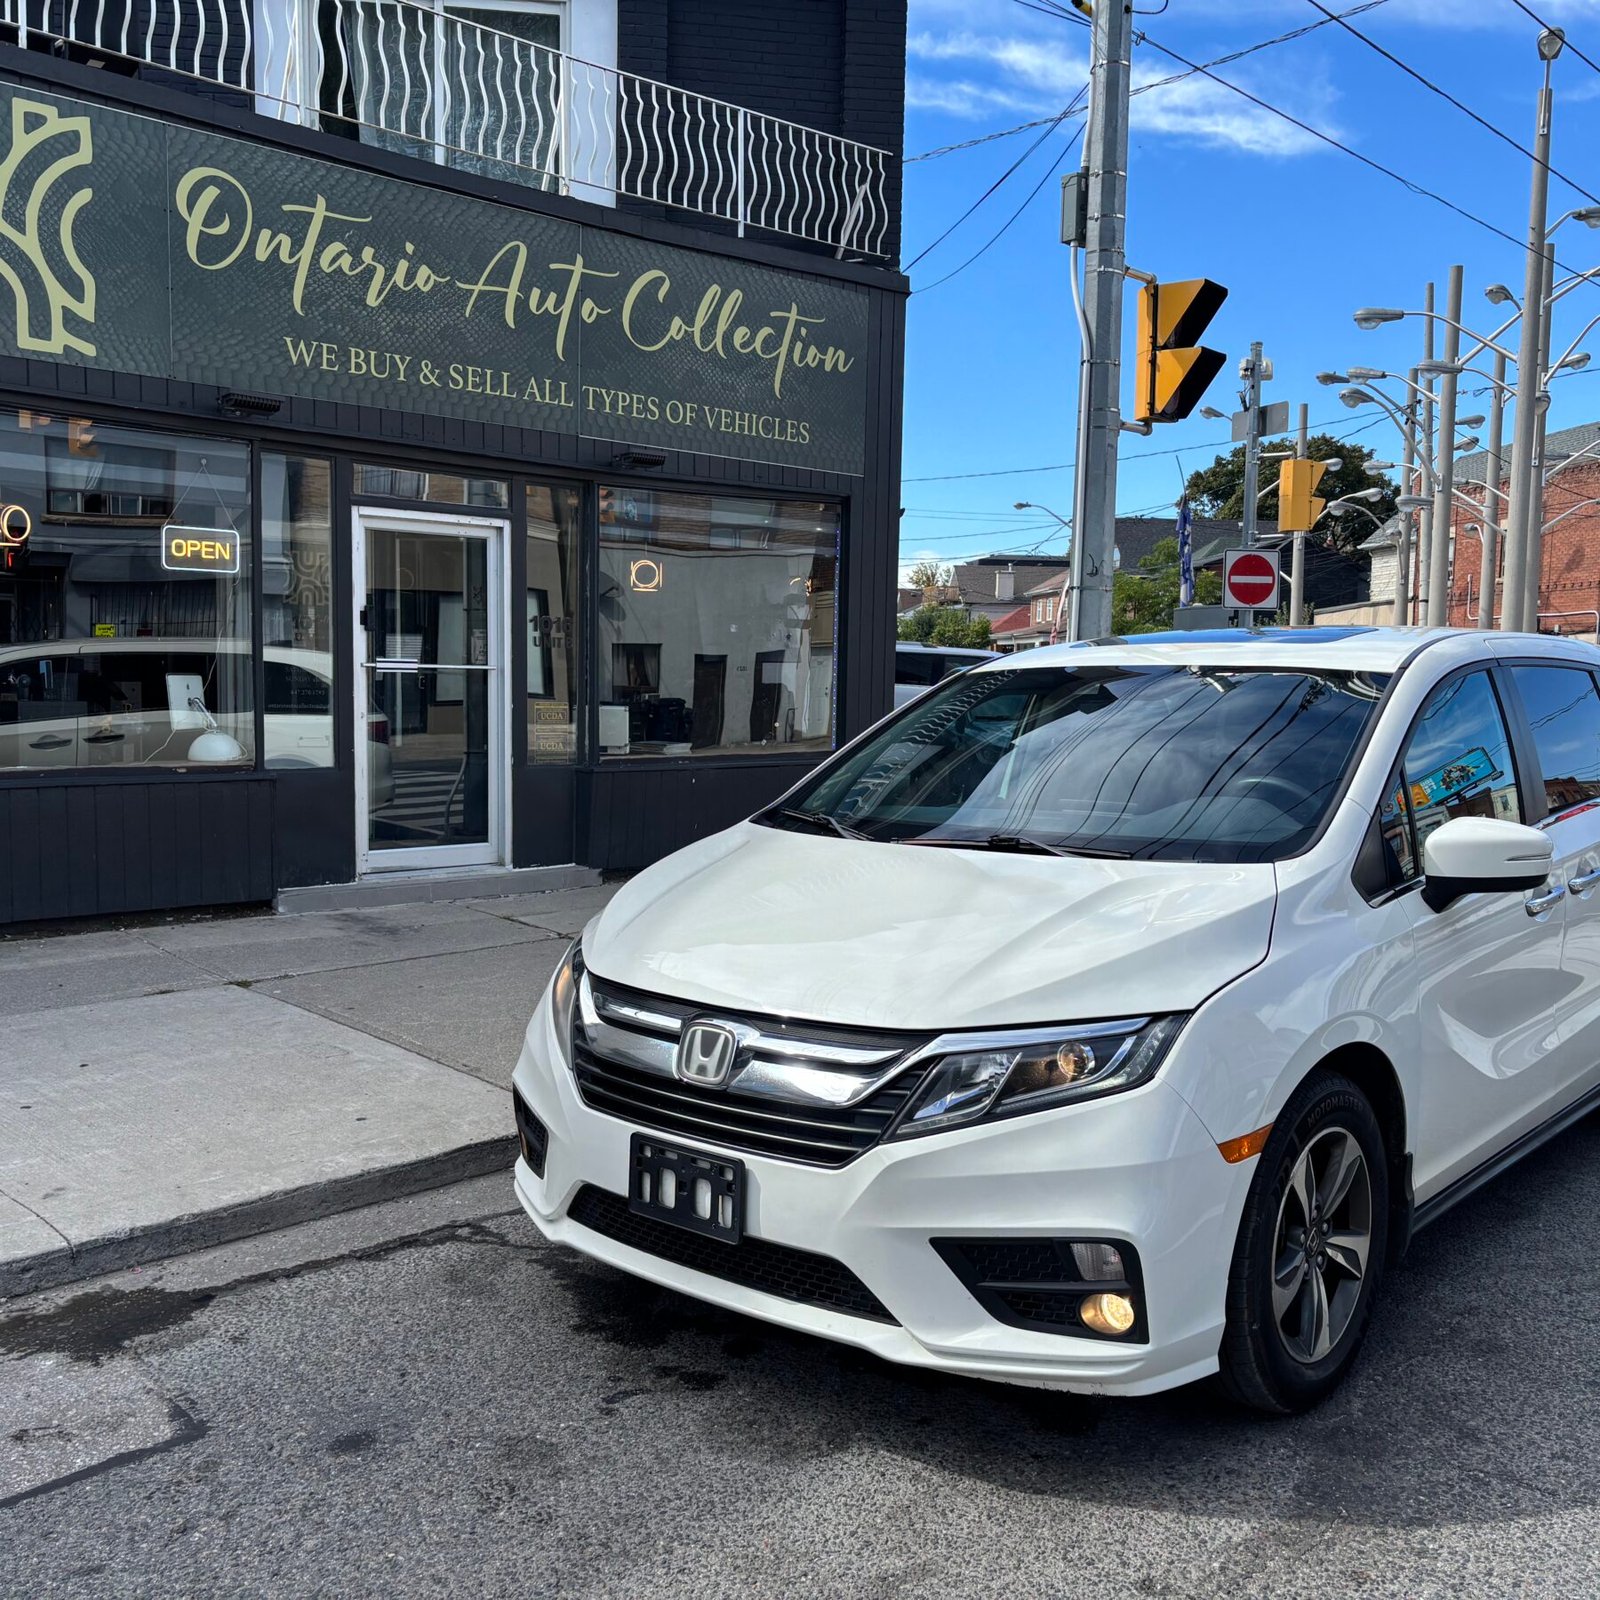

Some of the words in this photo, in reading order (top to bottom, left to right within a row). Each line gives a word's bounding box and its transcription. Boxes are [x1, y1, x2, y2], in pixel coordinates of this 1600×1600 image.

[175, 166, 450, 314] Ontario
[455, 240, 619, 362] Auto
[621, 268, 855, 399] Collection
[283, 336, 340, 373] WE
[348, 347, 413, 382] BUY
[419, 359, 441, 386] &
[448, 363, 518, 398] SELL
[523, 377, 574, 408] ALL
[582, 384, 660, 421] TYPES
[665, 399, 698, 427] OF
[703, 405, 811, 445] VEHICLES
[170, 538, 231, 561] OPEN
[540, 712, 564, 720] UCDA
[540, 742, 564, 750] UCDA
